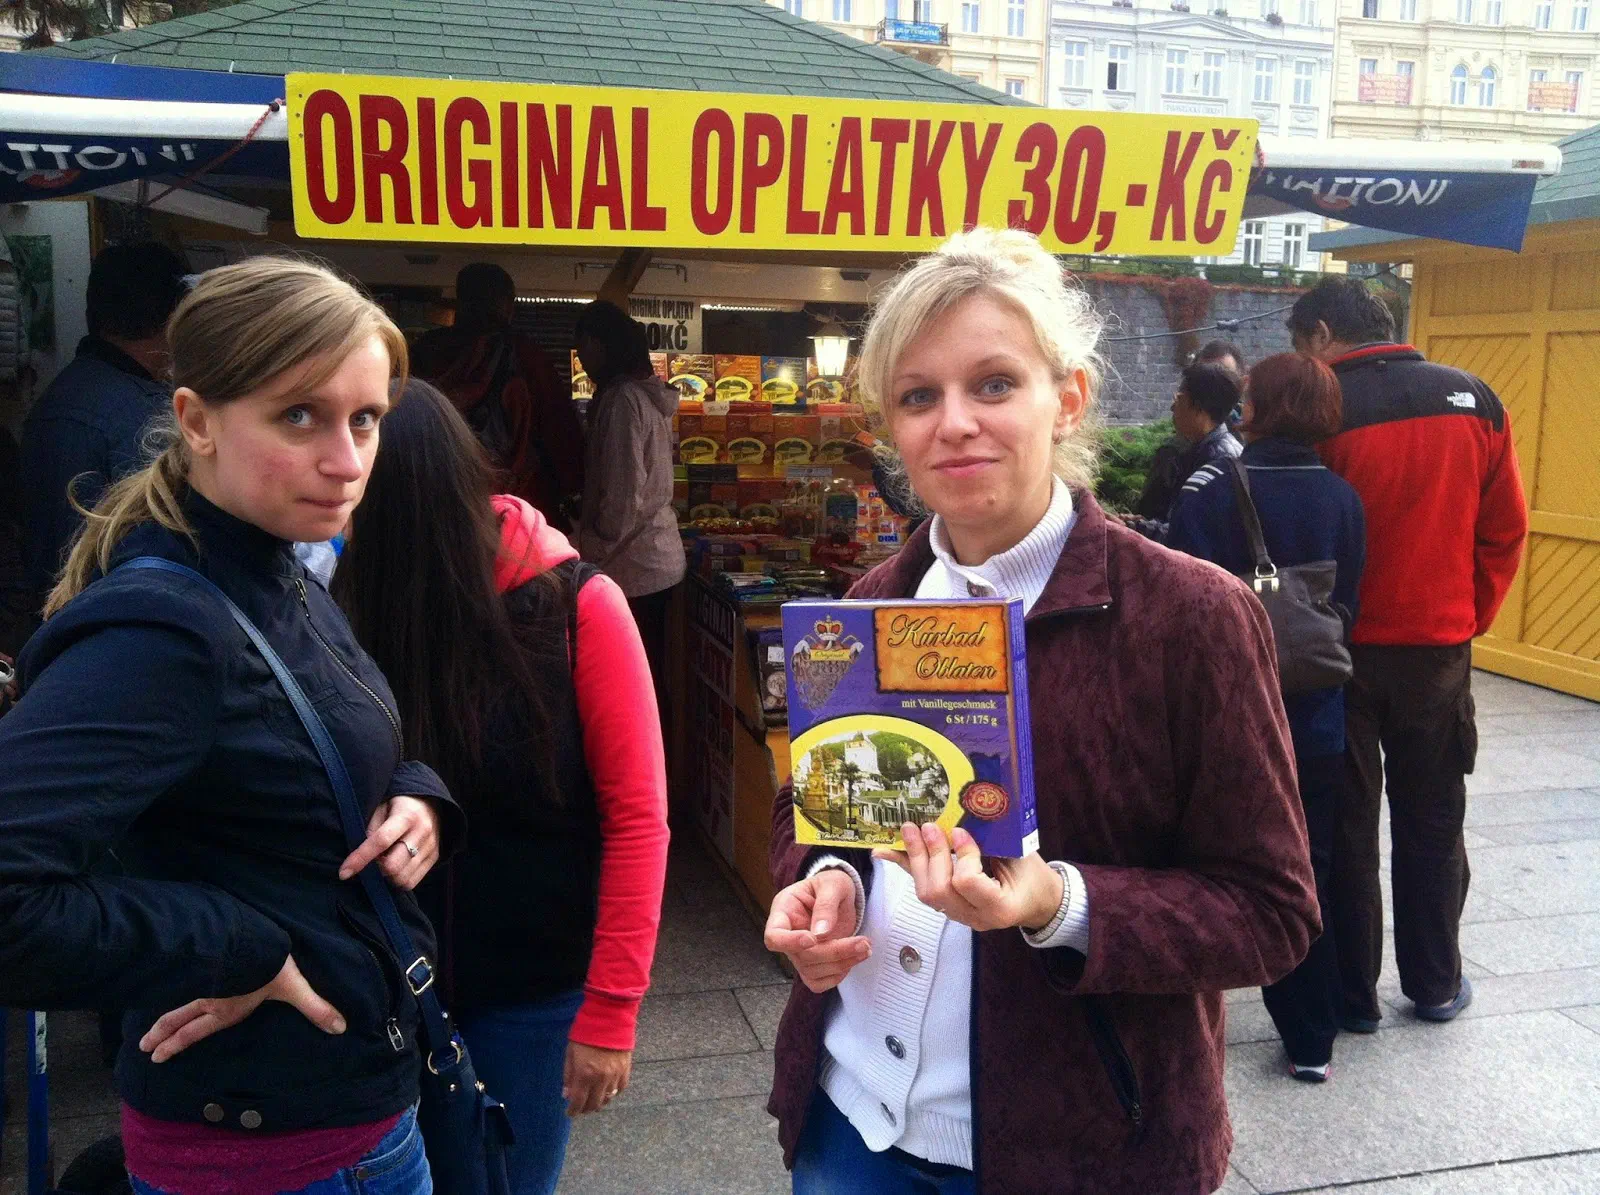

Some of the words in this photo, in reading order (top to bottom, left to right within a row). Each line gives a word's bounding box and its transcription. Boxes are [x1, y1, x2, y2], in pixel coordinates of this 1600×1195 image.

[303, 89, 667, 231] ORIGINAL
[690, 107, 1004, 237] OPLATKY
[662, 300, 694, 320] OPLATKY
[888, 614, 988, 648] Kurbad
[916, 652, 997, 680] Oblaten
[902, 700, 916, 708] mit
[917, 699, 996, 711] Vanillegeschmack
[946, 715, 952, 724] 6
[954, 715, 964, 724] St
[973, 715, 989, 724] 175
[991, 717, 998, 726] g
